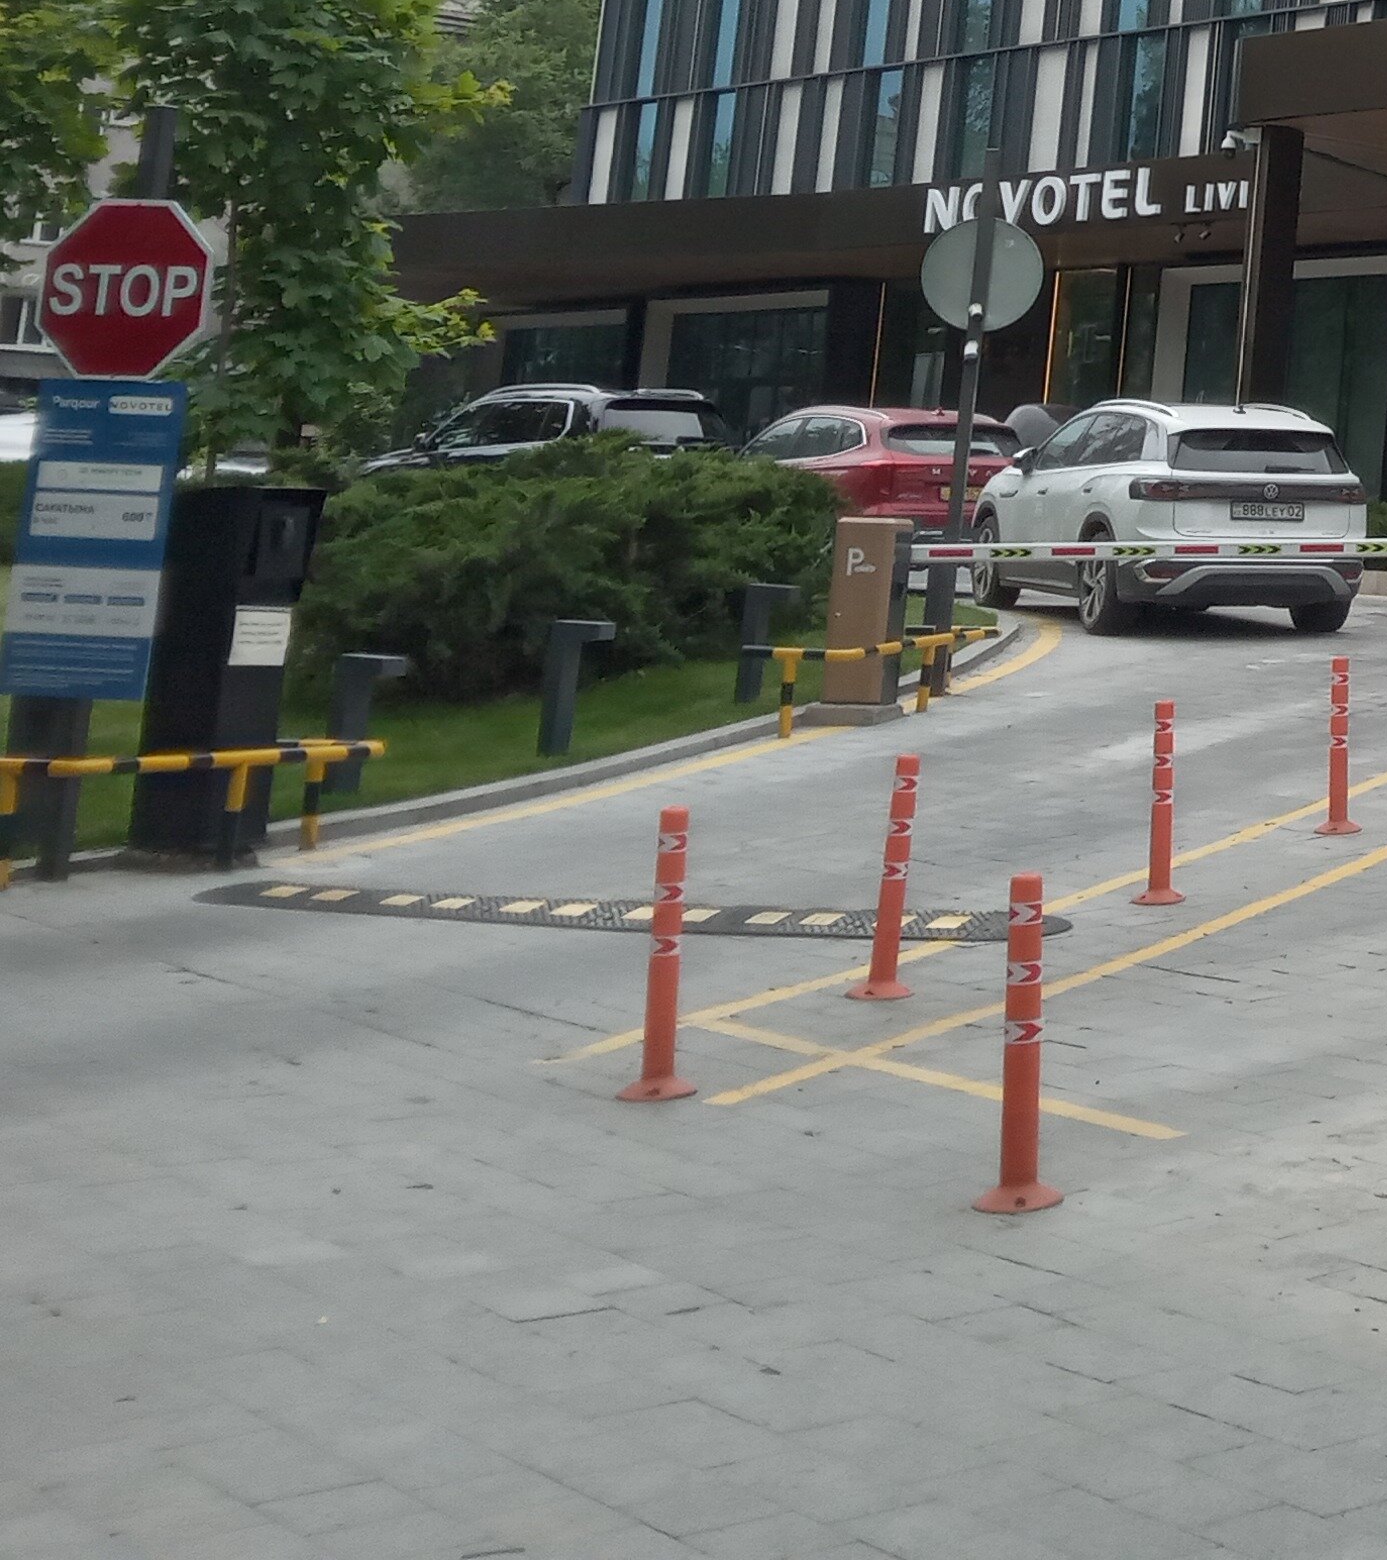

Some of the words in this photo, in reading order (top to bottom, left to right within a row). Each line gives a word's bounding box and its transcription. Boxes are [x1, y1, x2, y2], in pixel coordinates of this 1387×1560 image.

[1184, 180, 1249, 213] LIVI
[49, 263, 198, 317] STOP
[110, 401, 173, 412] NOVOTEL
